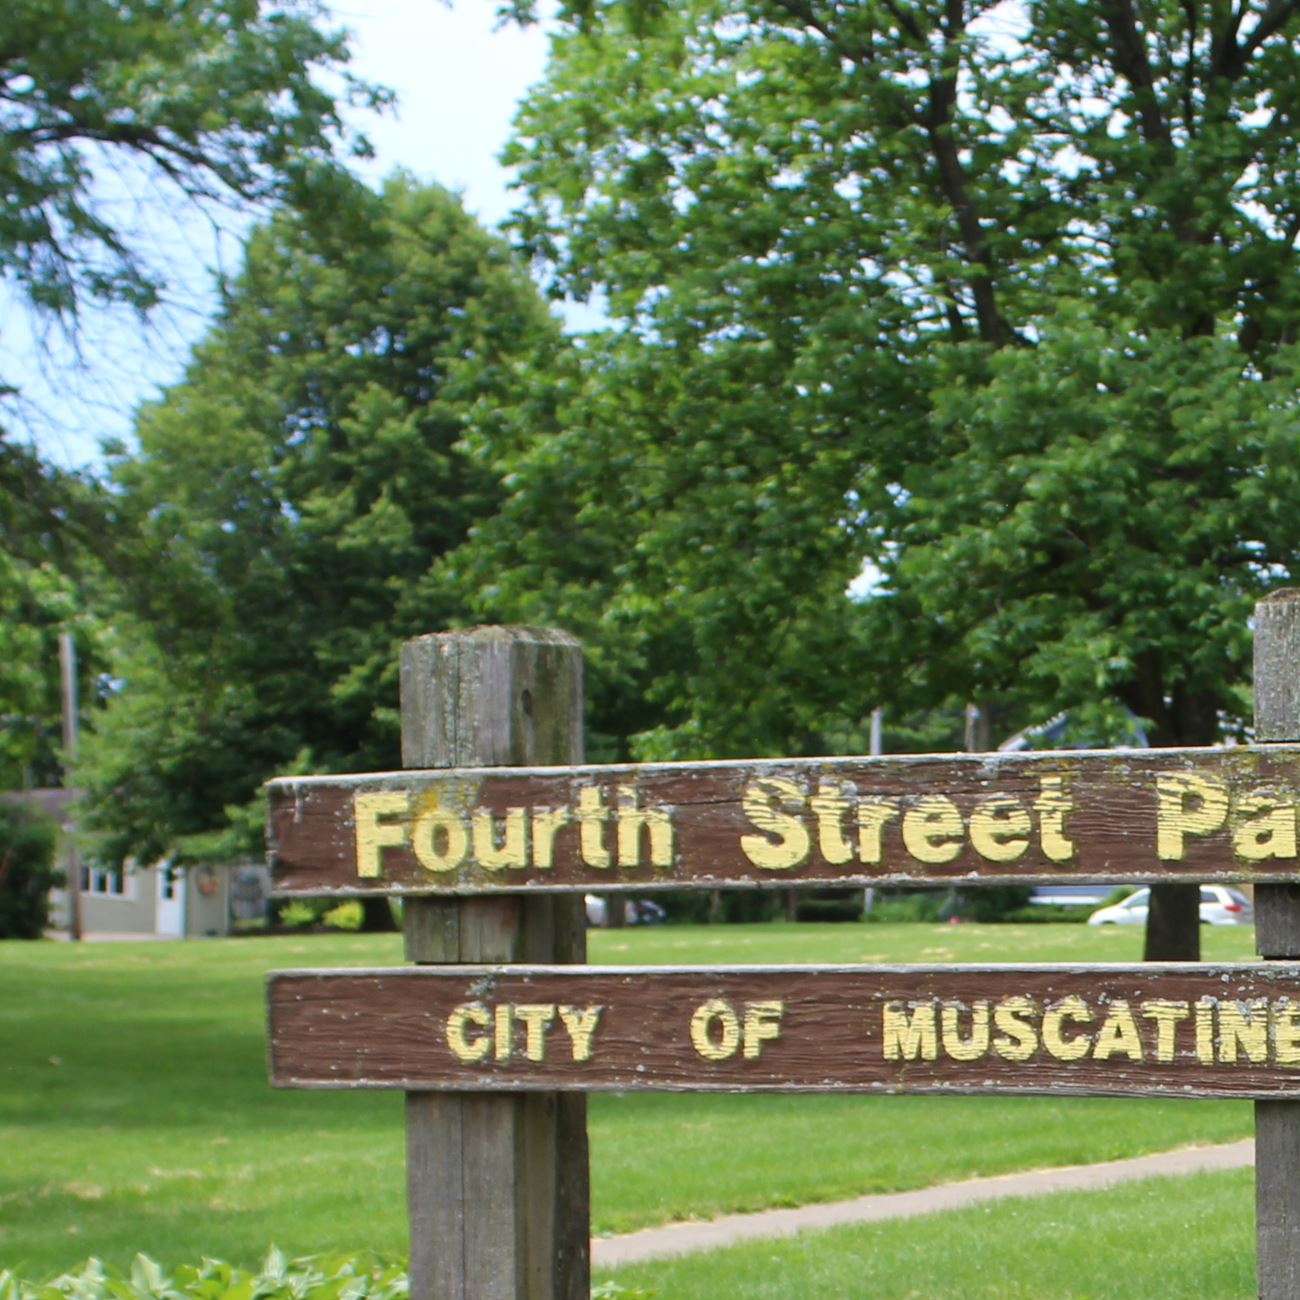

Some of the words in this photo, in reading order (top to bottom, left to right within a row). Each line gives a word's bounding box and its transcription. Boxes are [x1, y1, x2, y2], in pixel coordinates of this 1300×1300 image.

[354, 782, 676, 879] Fourth
[740, 776, 1077, 870] Street
[445, 1001, 602, 1063] CITY
[689, 999, 784, 1062] OF
